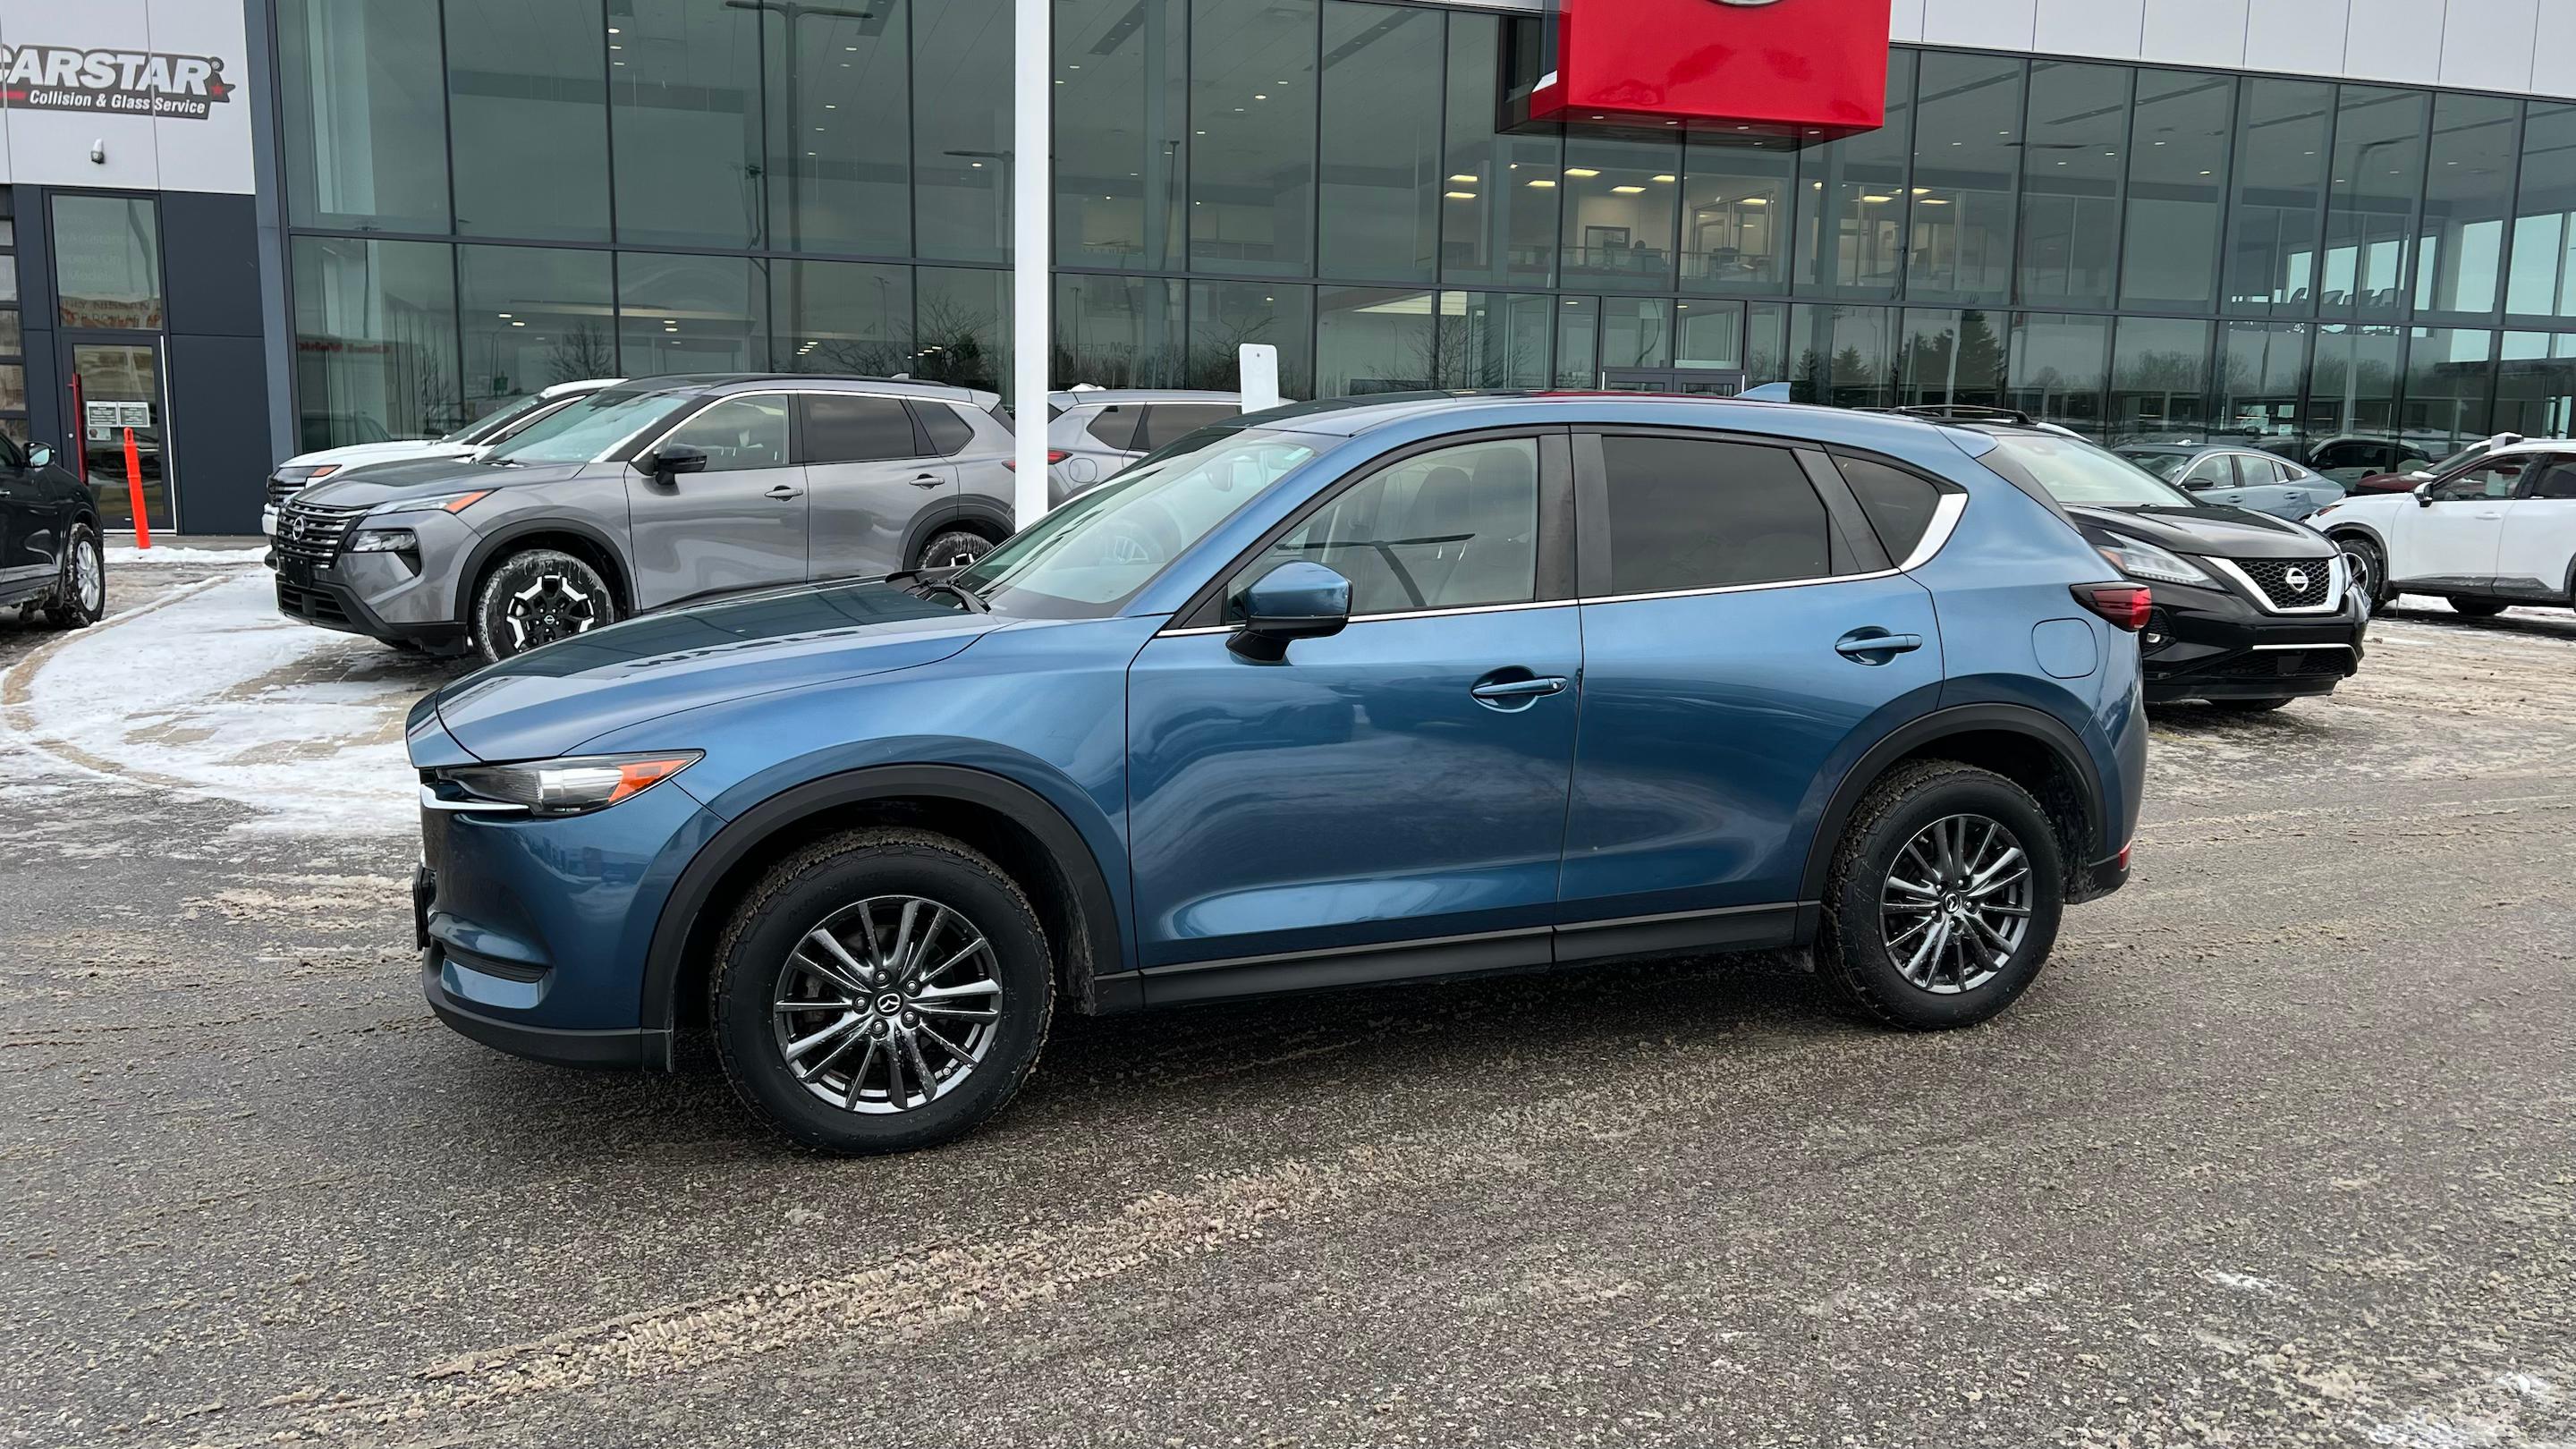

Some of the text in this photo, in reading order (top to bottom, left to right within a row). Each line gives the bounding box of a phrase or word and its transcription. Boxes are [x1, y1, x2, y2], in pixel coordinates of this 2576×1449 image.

[30, 89, 206, 114] Collision & Glass Service
